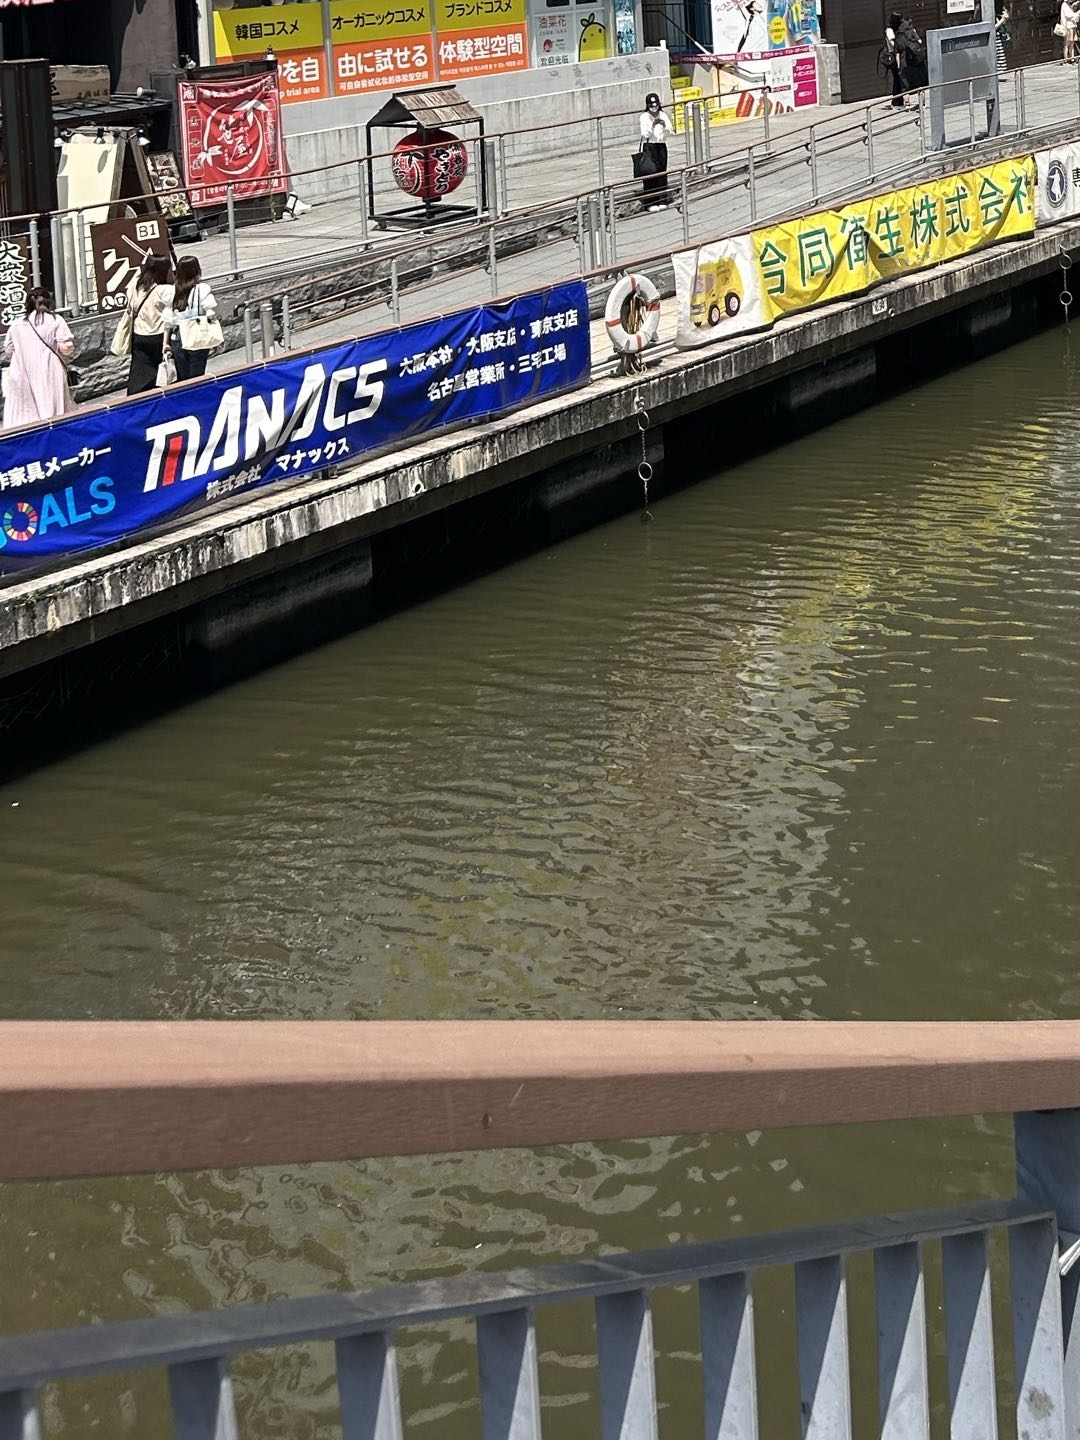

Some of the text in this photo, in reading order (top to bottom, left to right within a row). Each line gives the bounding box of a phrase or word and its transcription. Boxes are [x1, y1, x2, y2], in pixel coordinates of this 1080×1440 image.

[235, 19, 300, 41] 韓国コスメ
[331, 7, 425, 30] オーガニックコスメ
[337, 45, 428, 78] 由に試せる
[439, 32, 523, 64] 体験型空間
[303, 86, 320, 96] area
[139, 223, 158, 238] B1
[102, 294, 128, 310] 入口
[399, 308, 579, 378] 大阪本社・大阪支店・東京支店
[206, 436, 350, 501] 株式会社 マナックス
[0, 476, 116, 549] OALS
